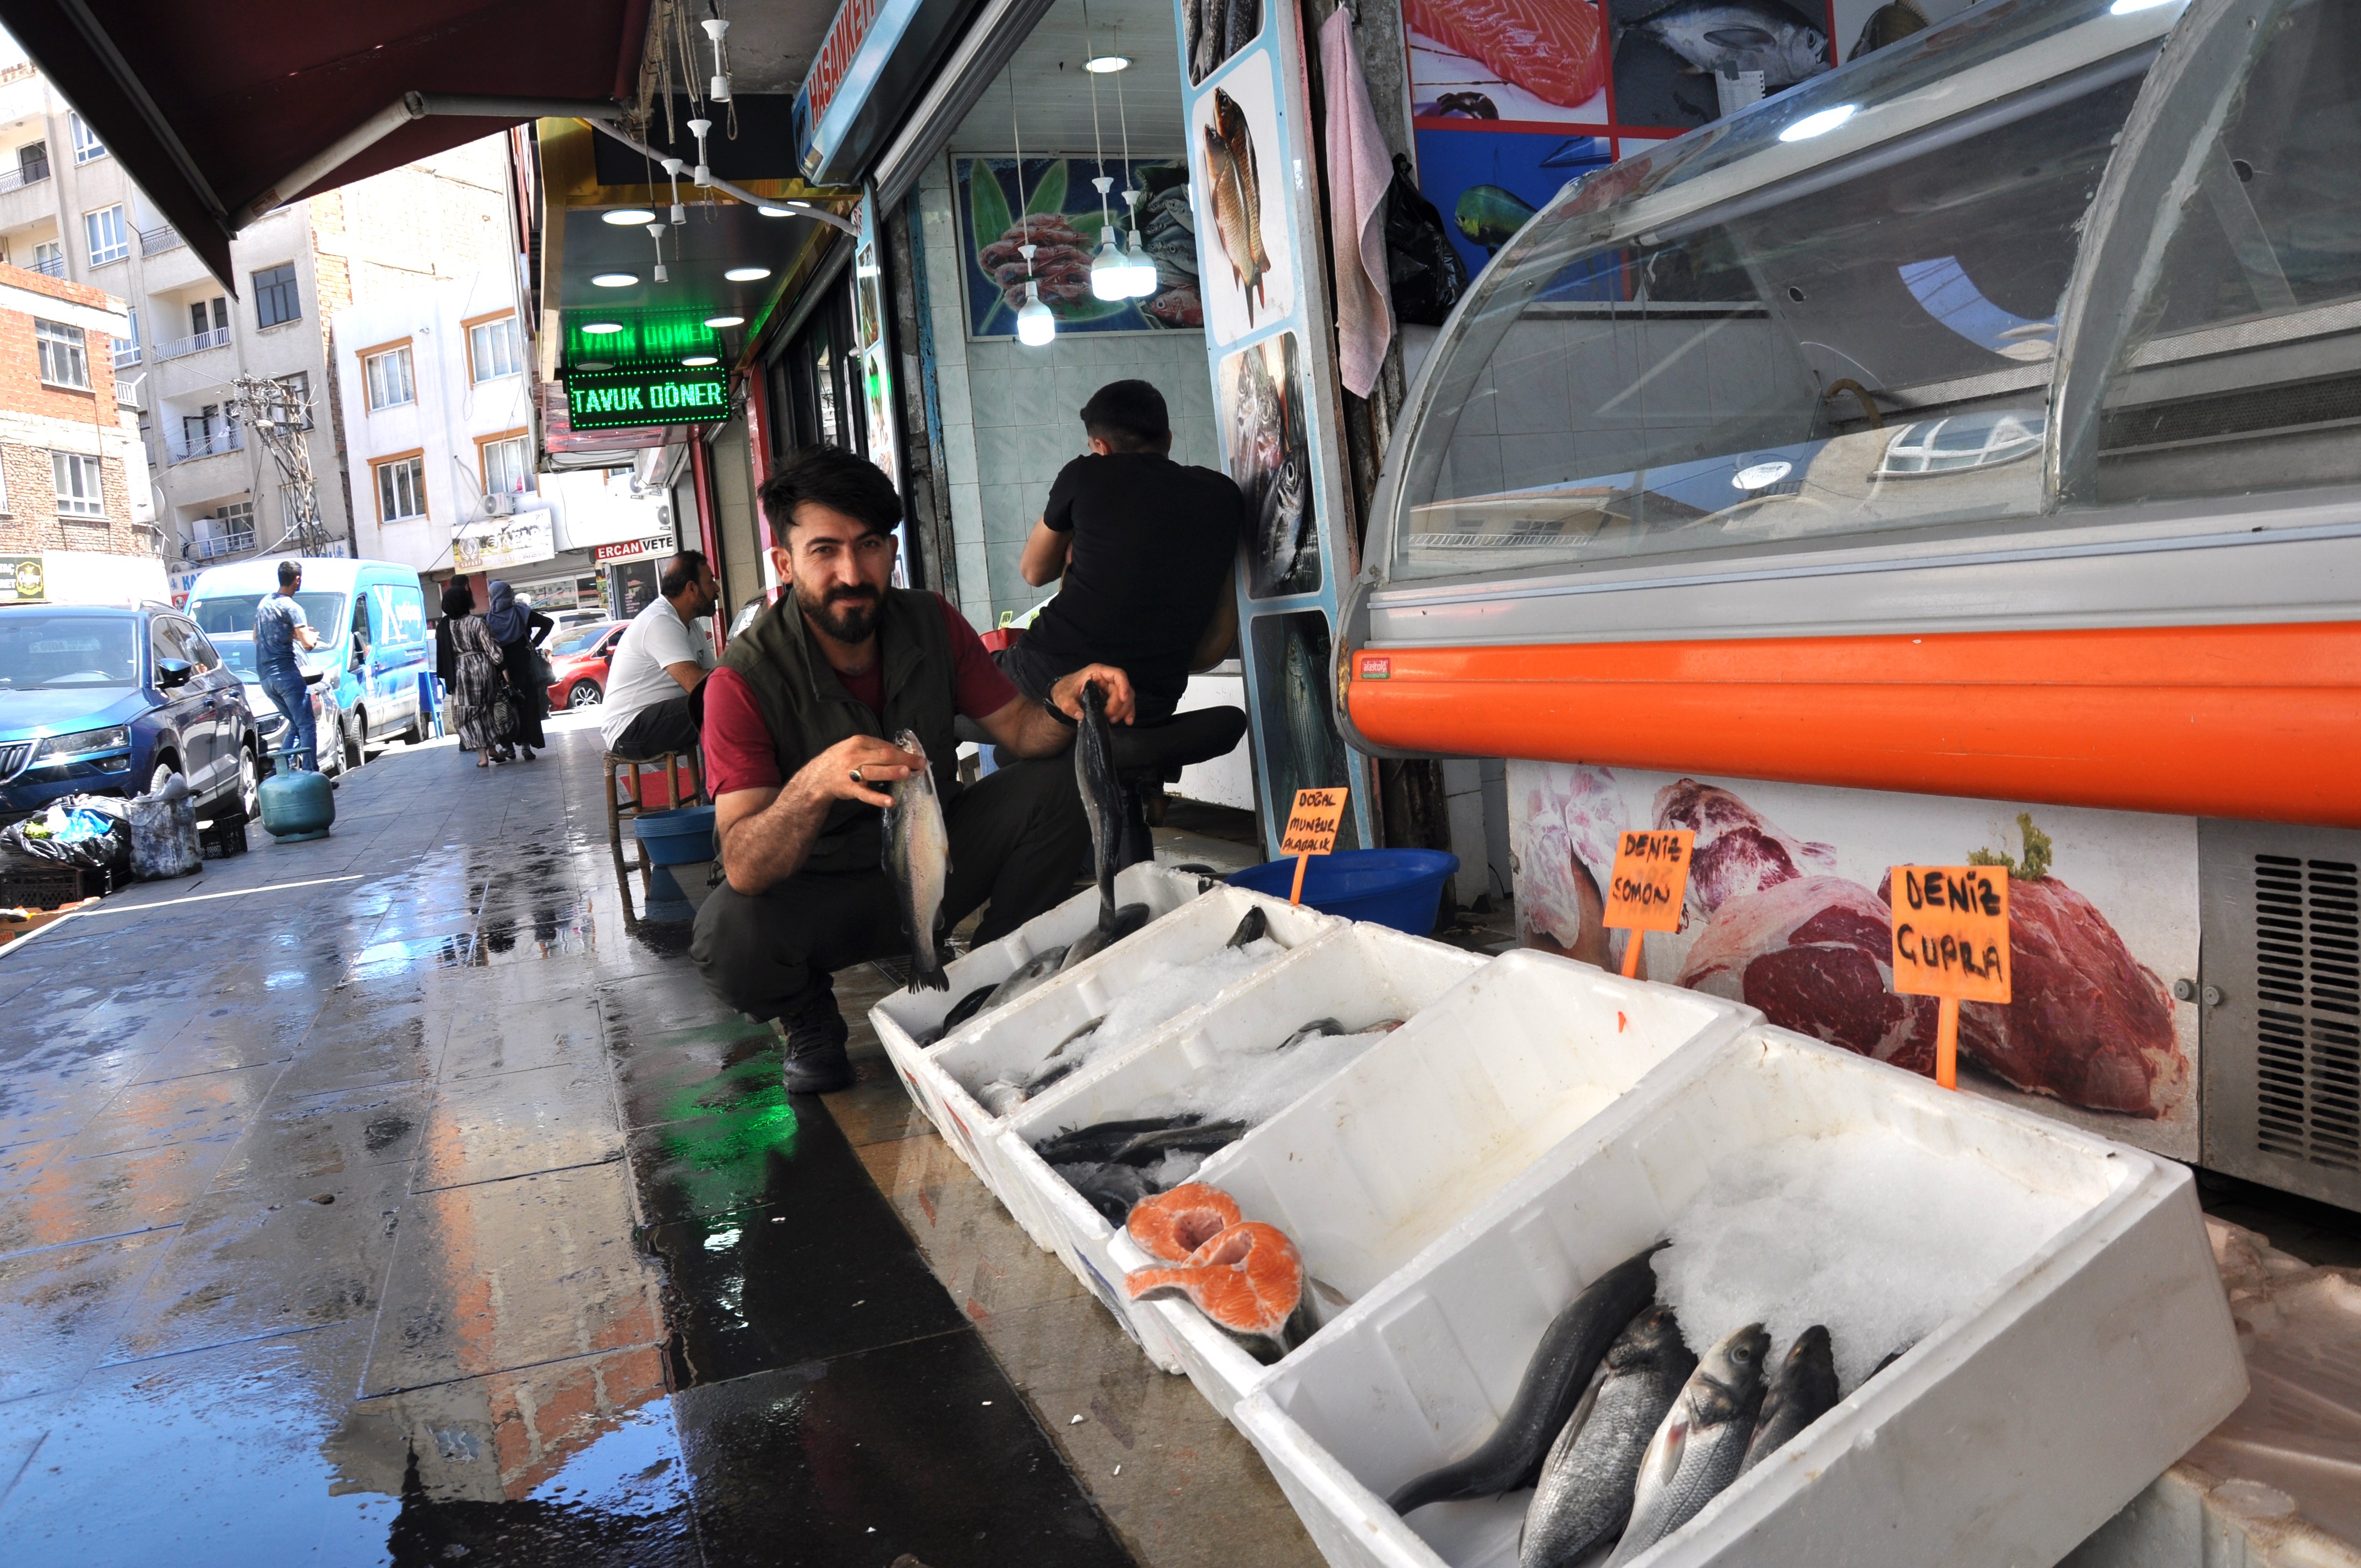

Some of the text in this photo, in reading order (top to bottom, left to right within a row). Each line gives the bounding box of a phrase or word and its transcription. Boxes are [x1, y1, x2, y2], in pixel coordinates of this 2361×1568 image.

[572, 382, 723, 413] TAVUK DÖNER
[598, 542, 639, 558] ERCAN
[1298, 791, 1336, 807] DOĞAL
[1289, 816, 1335, 833] MUNZUR
[1612, 876, 1670, 905] SOMON
